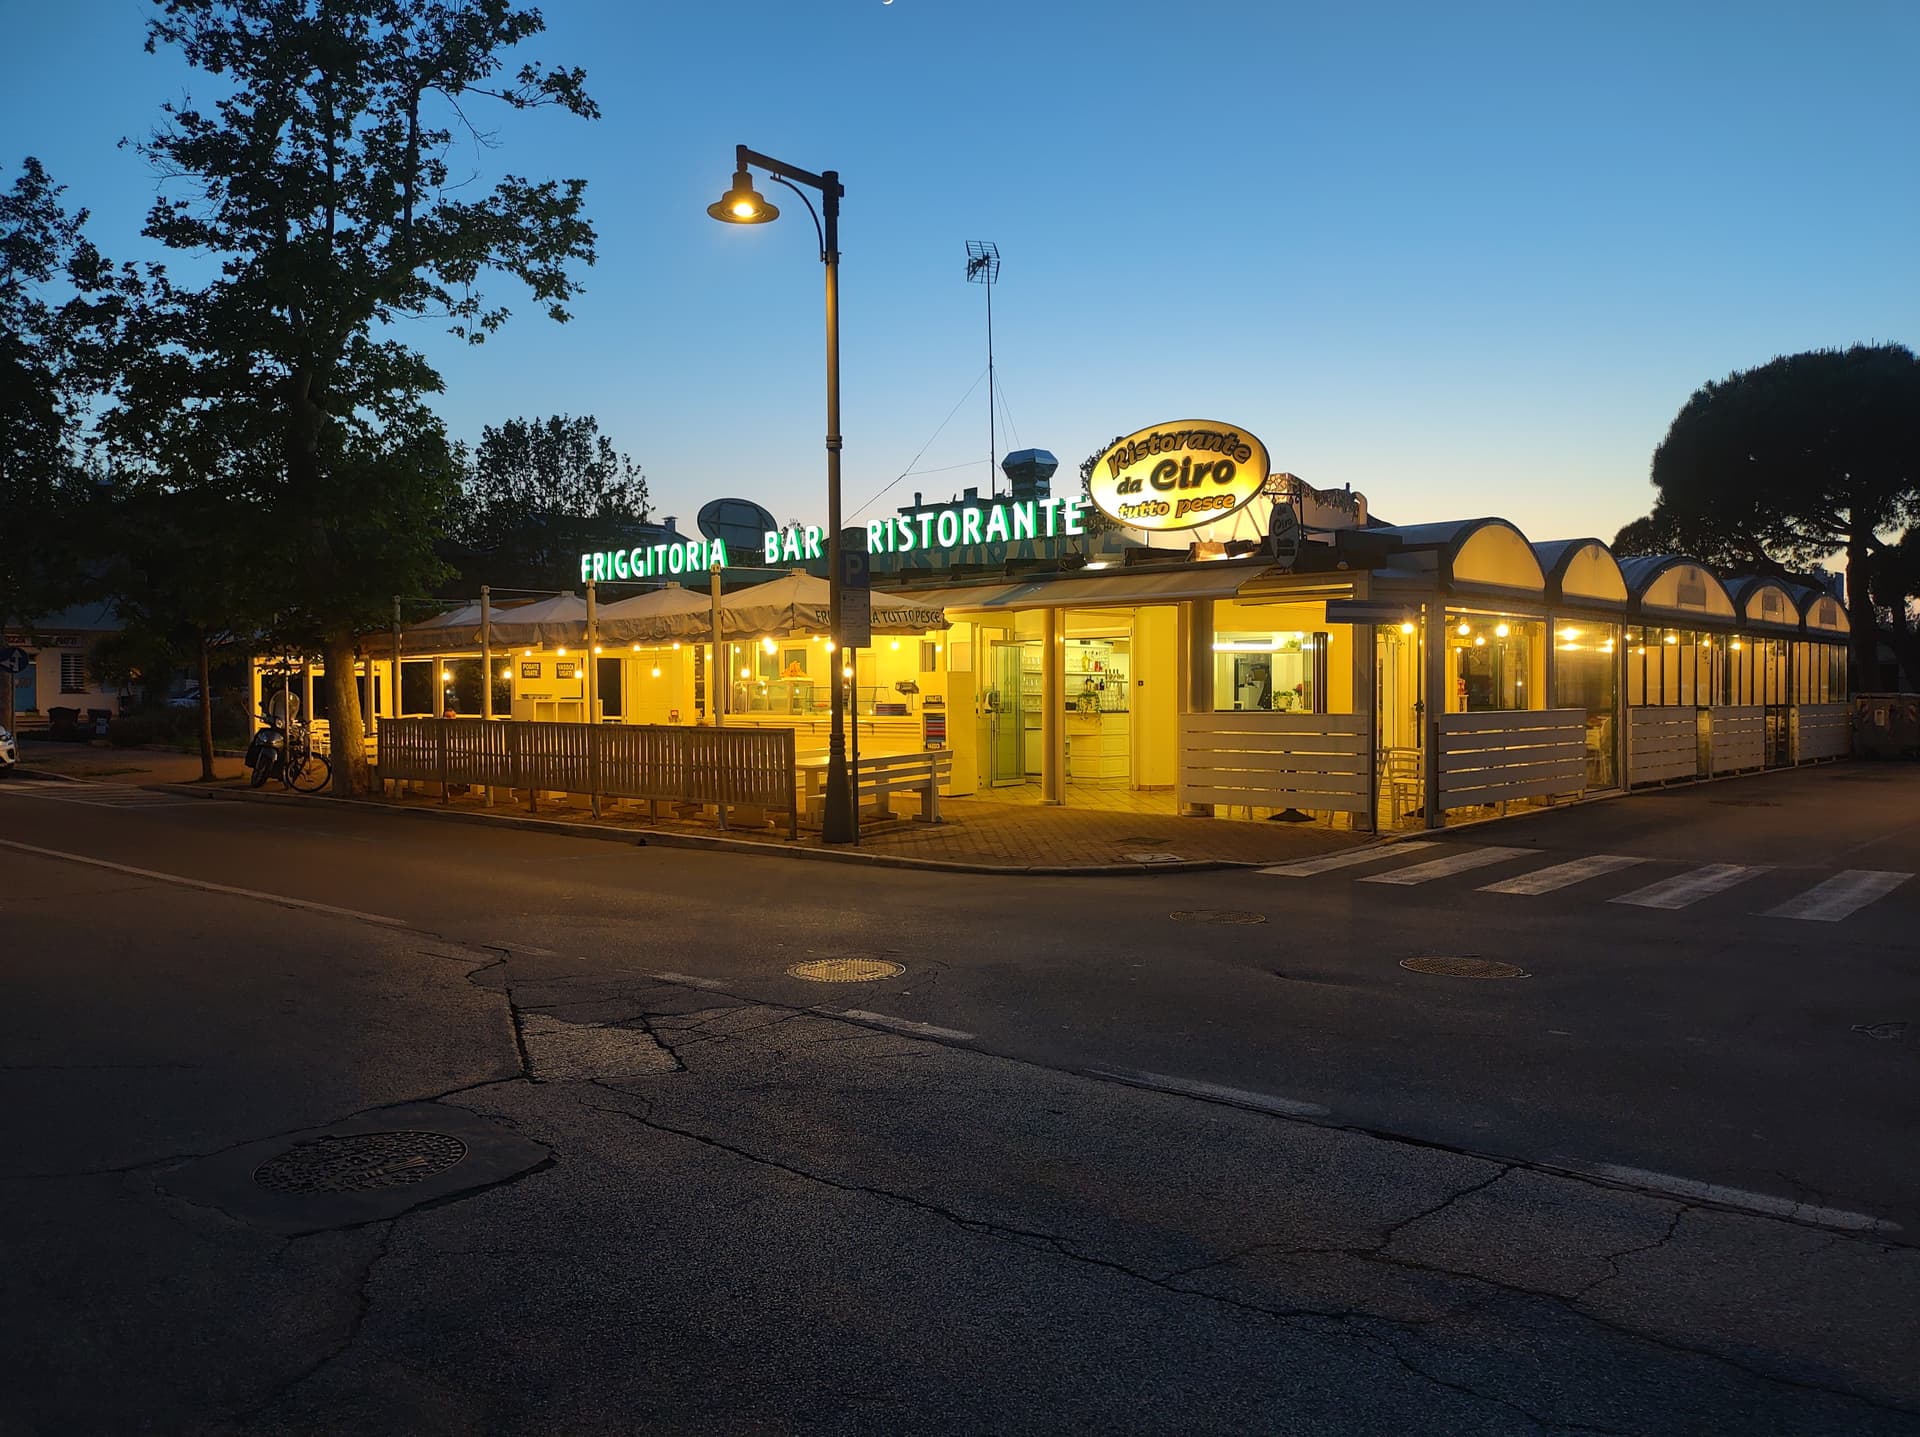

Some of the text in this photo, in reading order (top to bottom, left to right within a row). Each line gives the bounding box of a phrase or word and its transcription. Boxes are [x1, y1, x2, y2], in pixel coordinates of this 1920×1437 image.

[1107, 429, 1252, 480] Ristorante
[1116, 455, 1237, 495] da Ciro
[1118, 493, 1236, 520] tutto pesce
[581, 495, 1088, 583] FRIGGITORIA BAR RISTORANTE
[846, 554, 863, 585] P
[881, 609, 915, 624] TUTTO
[915, 609, 941, 623] PESCE
